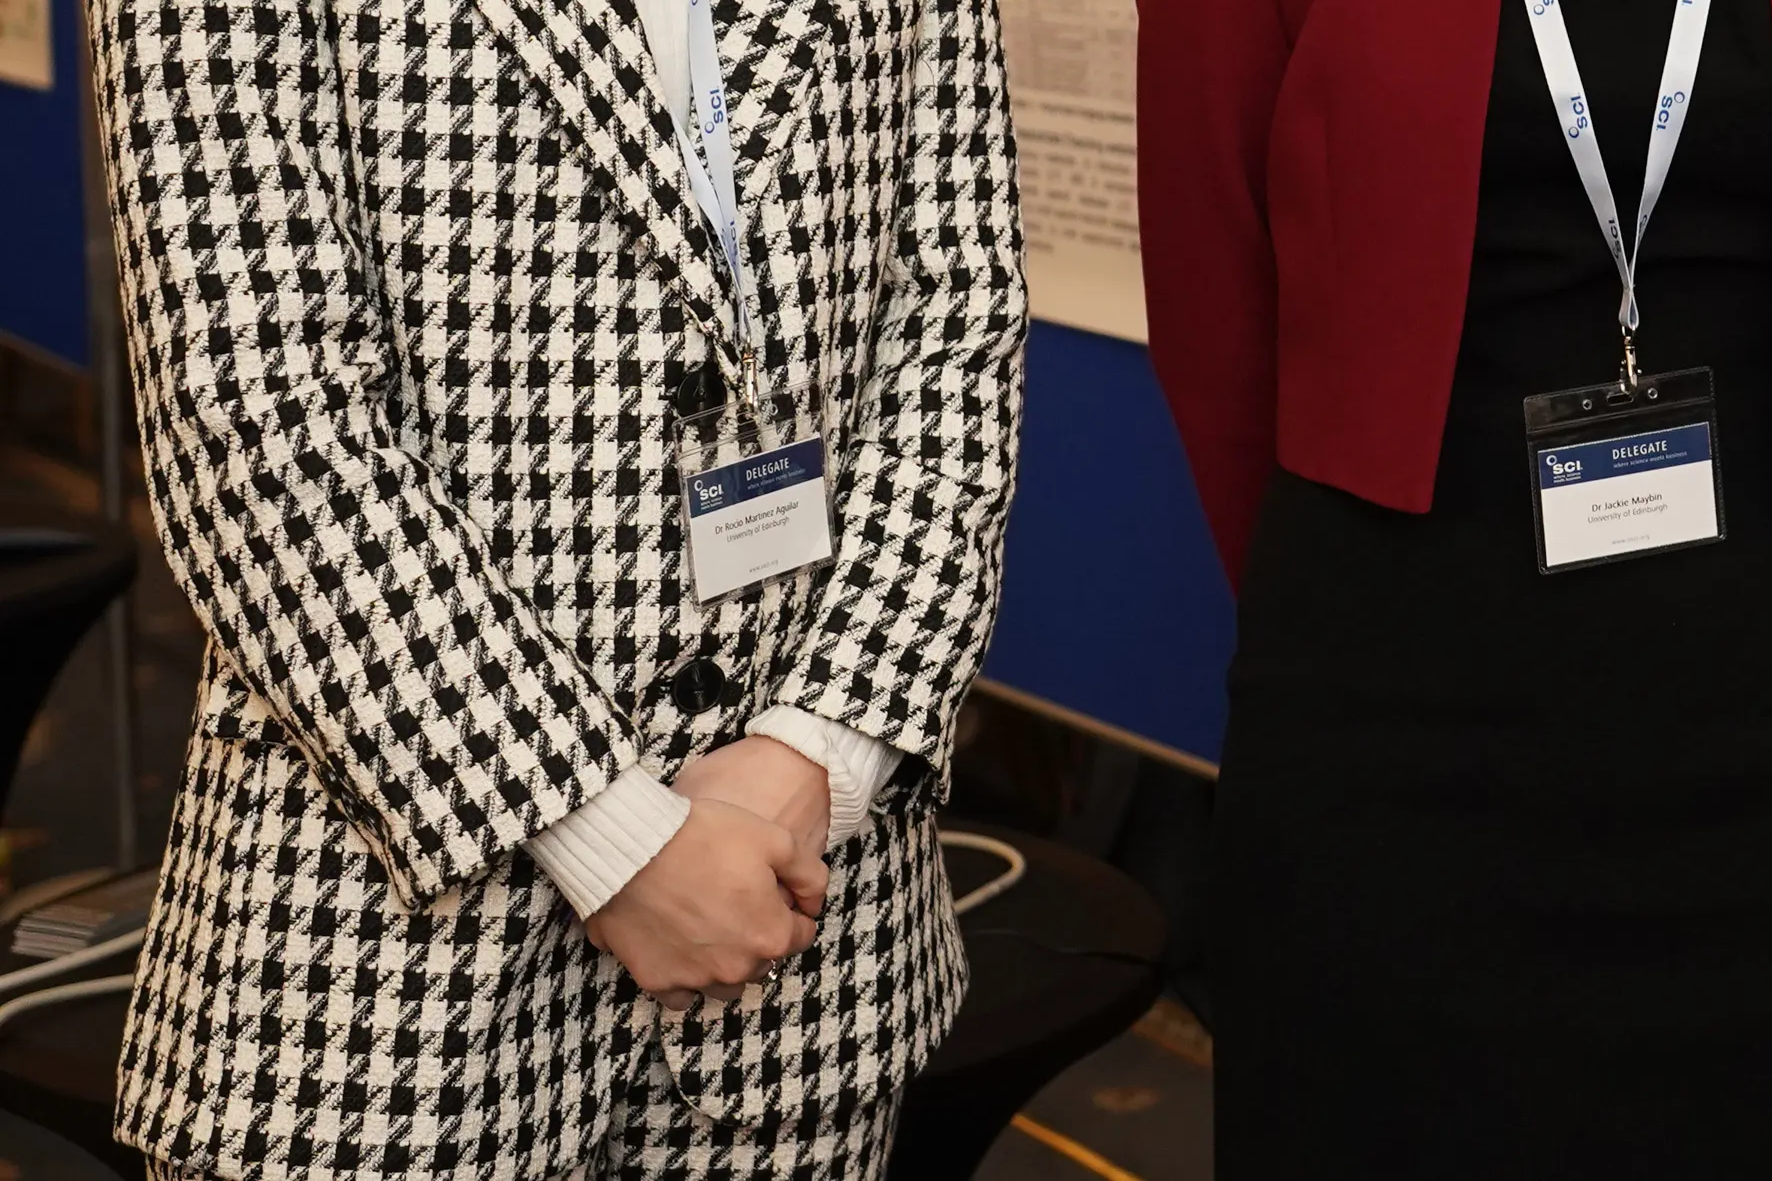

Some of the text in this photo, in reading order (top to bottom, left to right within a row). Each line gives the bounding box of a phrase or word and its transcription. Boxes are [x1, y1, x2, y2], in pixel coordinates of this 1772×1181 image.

[1612, 440, 1667, 459] DELEGATE
[746, 458, 790, 481] DELEGATE
[1591, 494, 1662, 512] Dr Jackie Maybin
[1587, 503, 1668, 523] University of Edinburgh
